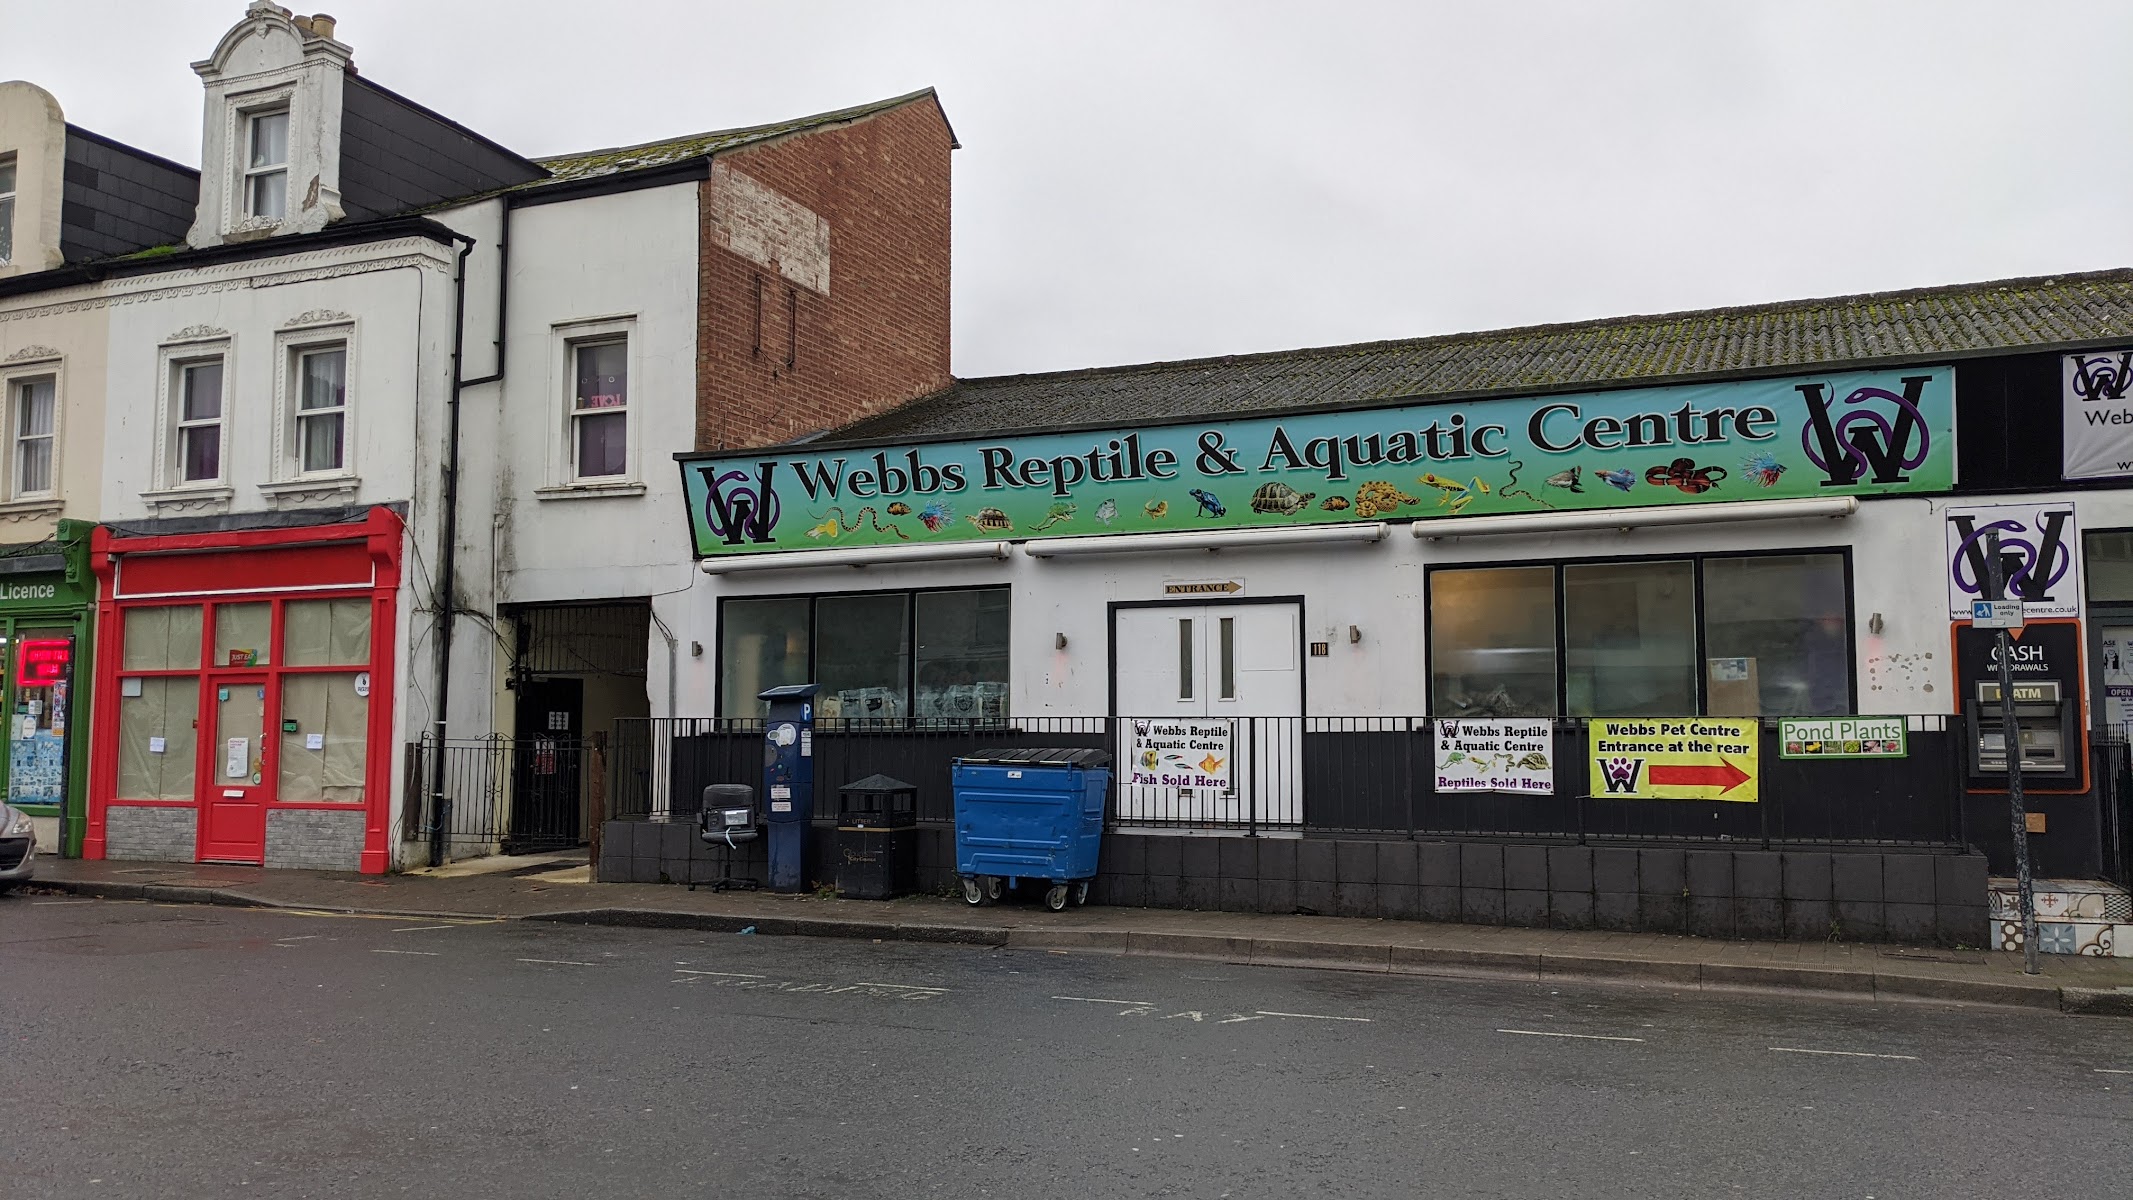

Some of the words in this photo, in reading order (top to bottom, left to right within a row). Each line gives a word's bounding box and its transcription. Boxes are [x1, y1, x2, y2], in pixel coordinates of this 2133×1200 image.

[790, 450, 966, 501] Webbs
[978, 432, 1178, 497] Reptile
[1195, 430, 1245, 475] &
[1259, 413, 1508, 481] Aquatic
[1527, 400, 1777, 453] Centre
[0, 583, 55, 600] Licence
[1166, 583, 1229, 593] ENTRANCE
[1993, 603, 2020, 611] Loading
[1999, 609, 2014, 617] only
[1313, 643, 1326, 656] 118
[231, 653, 243, 661] JUST
[1987, 663, 2049, 672] WIDRAWALS
[2110, 688, 2132, 697] OPEN
[803, 703, 811, 720] P
[1153, 725, 1187, 736] Webbs
[1190, 726, 1228, 738] Reptile
[1462, 726, 1500, 736] Webbs
[1504, 726, 1548, 739] Reptile
[1606, 723, 1656, 736] Webbs
[1660, 724, 1686, 736] Pet
[1690, 724, 1740, 737] Centre
[1784, 721, 1834, 740] Pond
[1840, 721, 1901, 740] Plants
[1136, 738, 1142, 748] &
[1145, 738, 1186, 751] Aquatic
[1189, 740, 1224, 750] Centre
[1440, 740, 1450, 750] &
[1454, 740, 1500, 753] Aquatic
[1504, 740, 1544, 751] Centre
[1598, 740, 1664, 752] Entrance
[1668, 741, 1684, 752] at
[1688, 740, 1713, 752] the
[1717, 744, 1750, 754] rear
[1131, 772, 1157, 785] Fish
[1162, 774, 1190, 786] Sold
[1194, 775, 1227, 787] Here
[1438, 777, 1486, 790] Reptiles
[1490, 777, 1517, 788] Sold
[1521, 778, 1551, 789] Here
